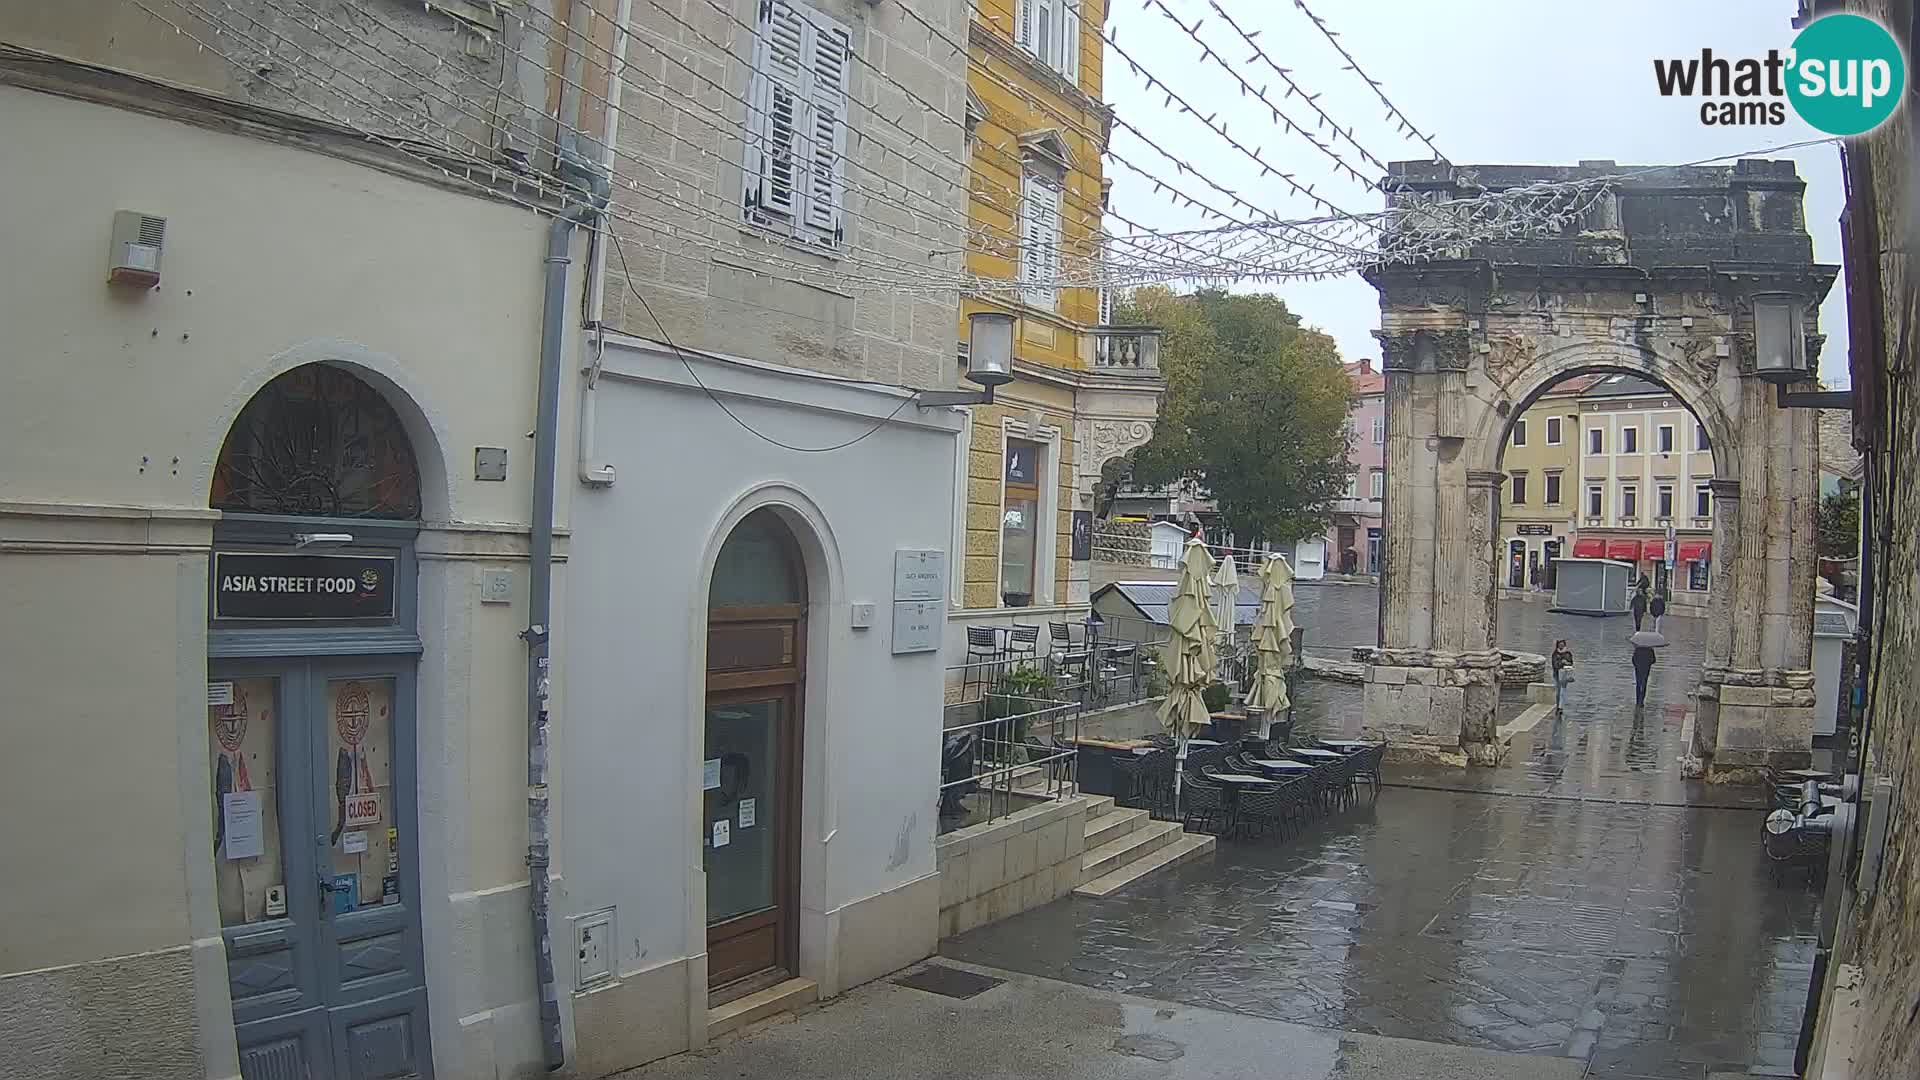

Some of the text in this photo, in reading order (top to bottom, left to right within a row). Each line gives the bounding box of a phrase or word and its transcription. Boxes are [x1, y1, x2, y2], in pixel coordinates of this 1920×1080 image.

[222, 575, 356, 593] ASIA STREET FOOD
[348, 800, 377, 818] CLOSED
